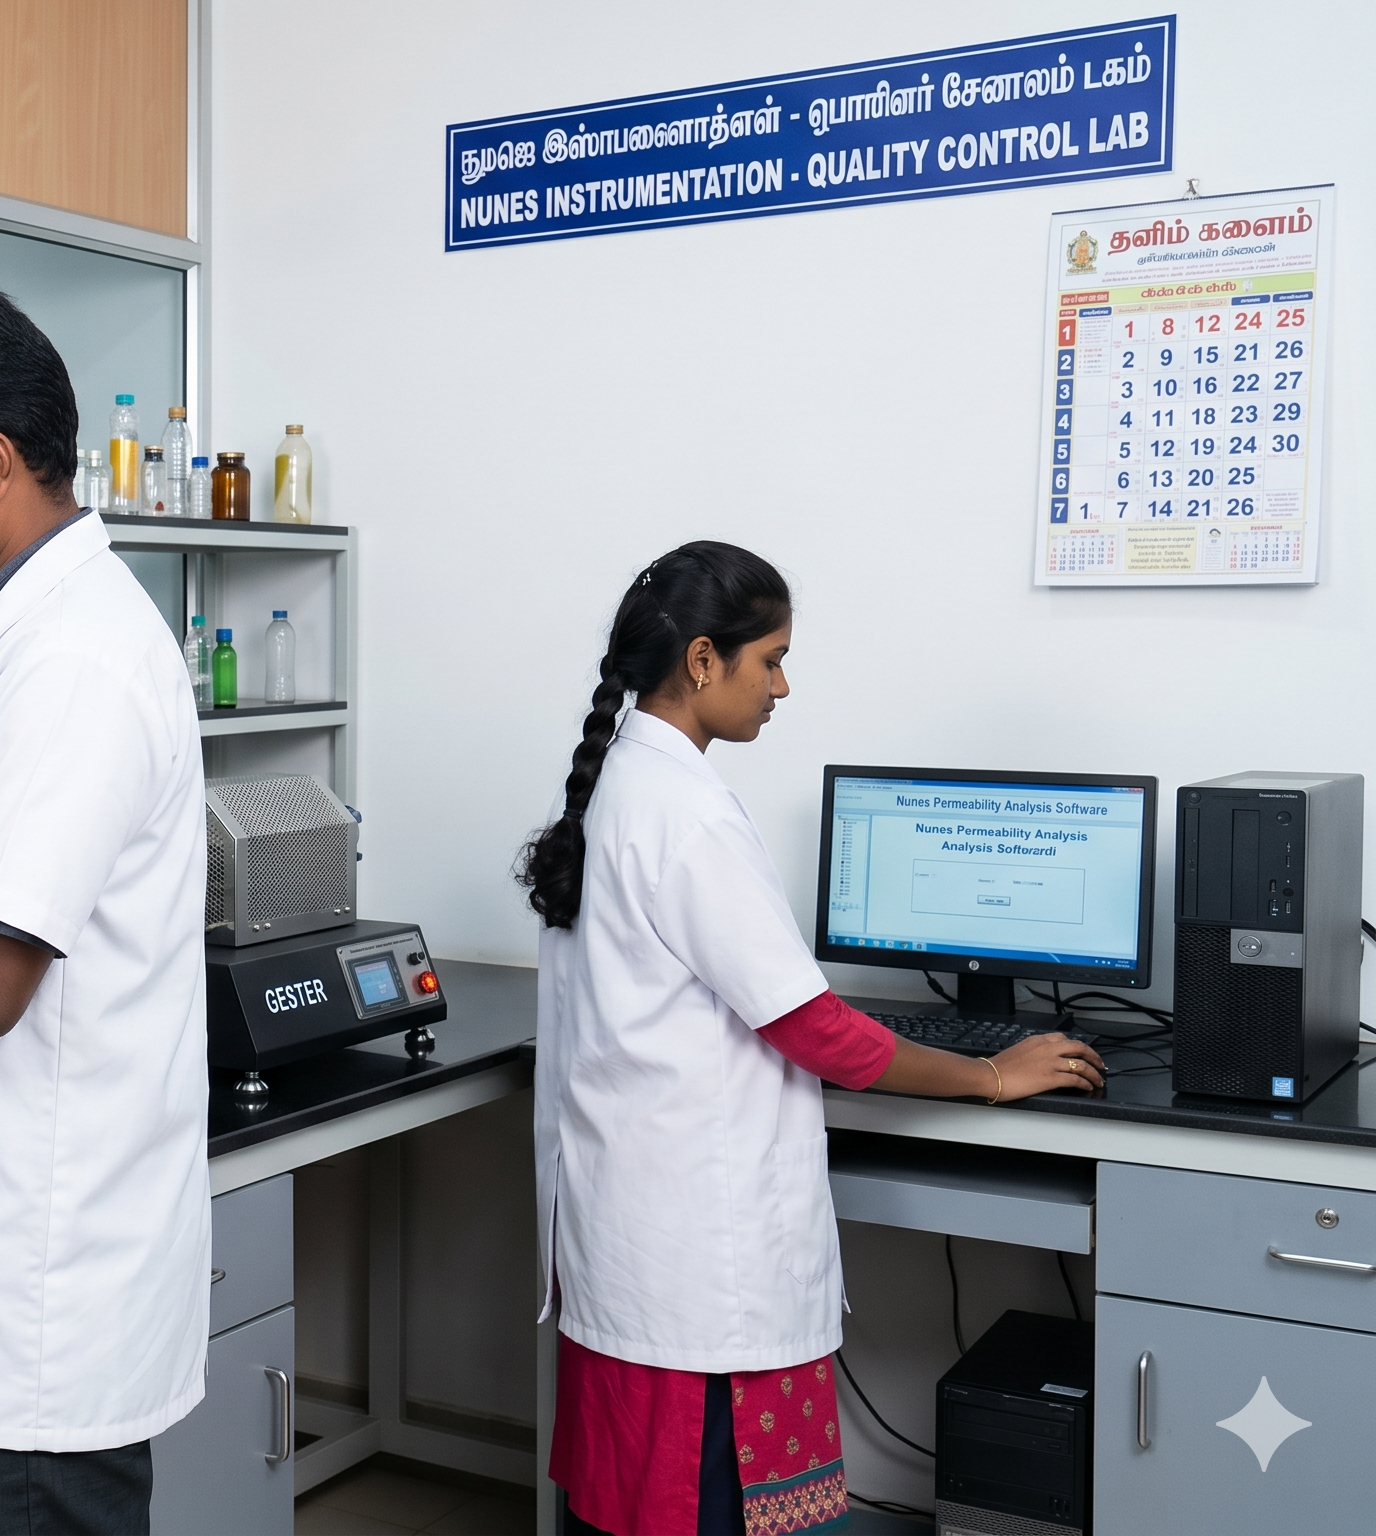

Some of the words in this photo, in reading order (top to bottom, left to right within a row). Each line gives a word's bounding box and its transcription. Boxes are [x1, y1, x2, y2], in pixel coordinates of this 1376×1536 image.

[461, 188, 539, 229] NUNES
[546, 159, 783, 219] INSTRUMENTATION
[790, 172, 800, 182] -
[807, 139, 930, 189] QUALITY
[937, 121, 1080, 172] CONTROL
[1088, 110, 1149, 154] LAB
[1062, 326, 1071, 340] 1
[1124, 321, 1133, 338] 1
[1161, 318, 1175, 336] 8
[1194, 314, 1221, 333] 12
[1234, 311, 1262, 331] 24
[1276, 308, 1305, 328] 25
[1060, 354, 1072, 370] 2
[1122, 351, 1135, 368] 2
[1160, 349, 1172, 366] 9
[1193, 346, 1219, 364] 15
[1233, 342, 1259, 362] 21
[1274, 340, 1304, 360] 26
[1059, 384, 1070, 399] 3
[1121, 381, 1133, 399] 3
[1153, 379, 1177, 397] 10
[1192, 376, 1217, 395] 16
[1232, 373, 1260, 393] 22
[1273, 371, 1303, 390] 27
[1057, 414, 1069, 429] 4
[1119, 411, 1133, 428] 4
[1152, 409, 1174, 427] 11
[1191, 407, 1216, 425] 18
[1230, 405, 1258, 424] 23
[1272, 402, 1301, 422] 29
[1057, 444, 1068, 459] 5
[1118, 442, 1131, 459] 5
[1150, 439, 1175, 457] 12
[1190, 438, 1215, 456] 19
[1229, 436, 1257, 454] 24
[1271, 434, 1300, 452] 30
[1055, 473, 1067, 489] 6
[1117, 471, 1130, 489] 6
[1149, 469, 1173, 488] 13
[1187, 469, 1214, 486] 20
[1227, 467, 1255, 485] 25
[1054, 503, 1065, 518] 7
[1080, 503, 1088, 520] 1
[1117, 501, 1129, 519] 7
[1148, 500, 1172, 518] 14
[1187, 499, 1211, 517] 21
[1226, 498, 1254, 516] 26
[896, 795, 930, 808] Nunes
[933, 797, 1001, 814] Permeability
[1004, 800, 1052, 816] Analysis
[1055, 802, 1108, 816] Software
[915, 823, 953, 835] Nunes
[956, 825, 1031, 841] Permeability
[1034, 829, 1088, 843] Analysis
[941, 841, 993, 855] Analysis
[265, 978, 328, 1014] GESTER
